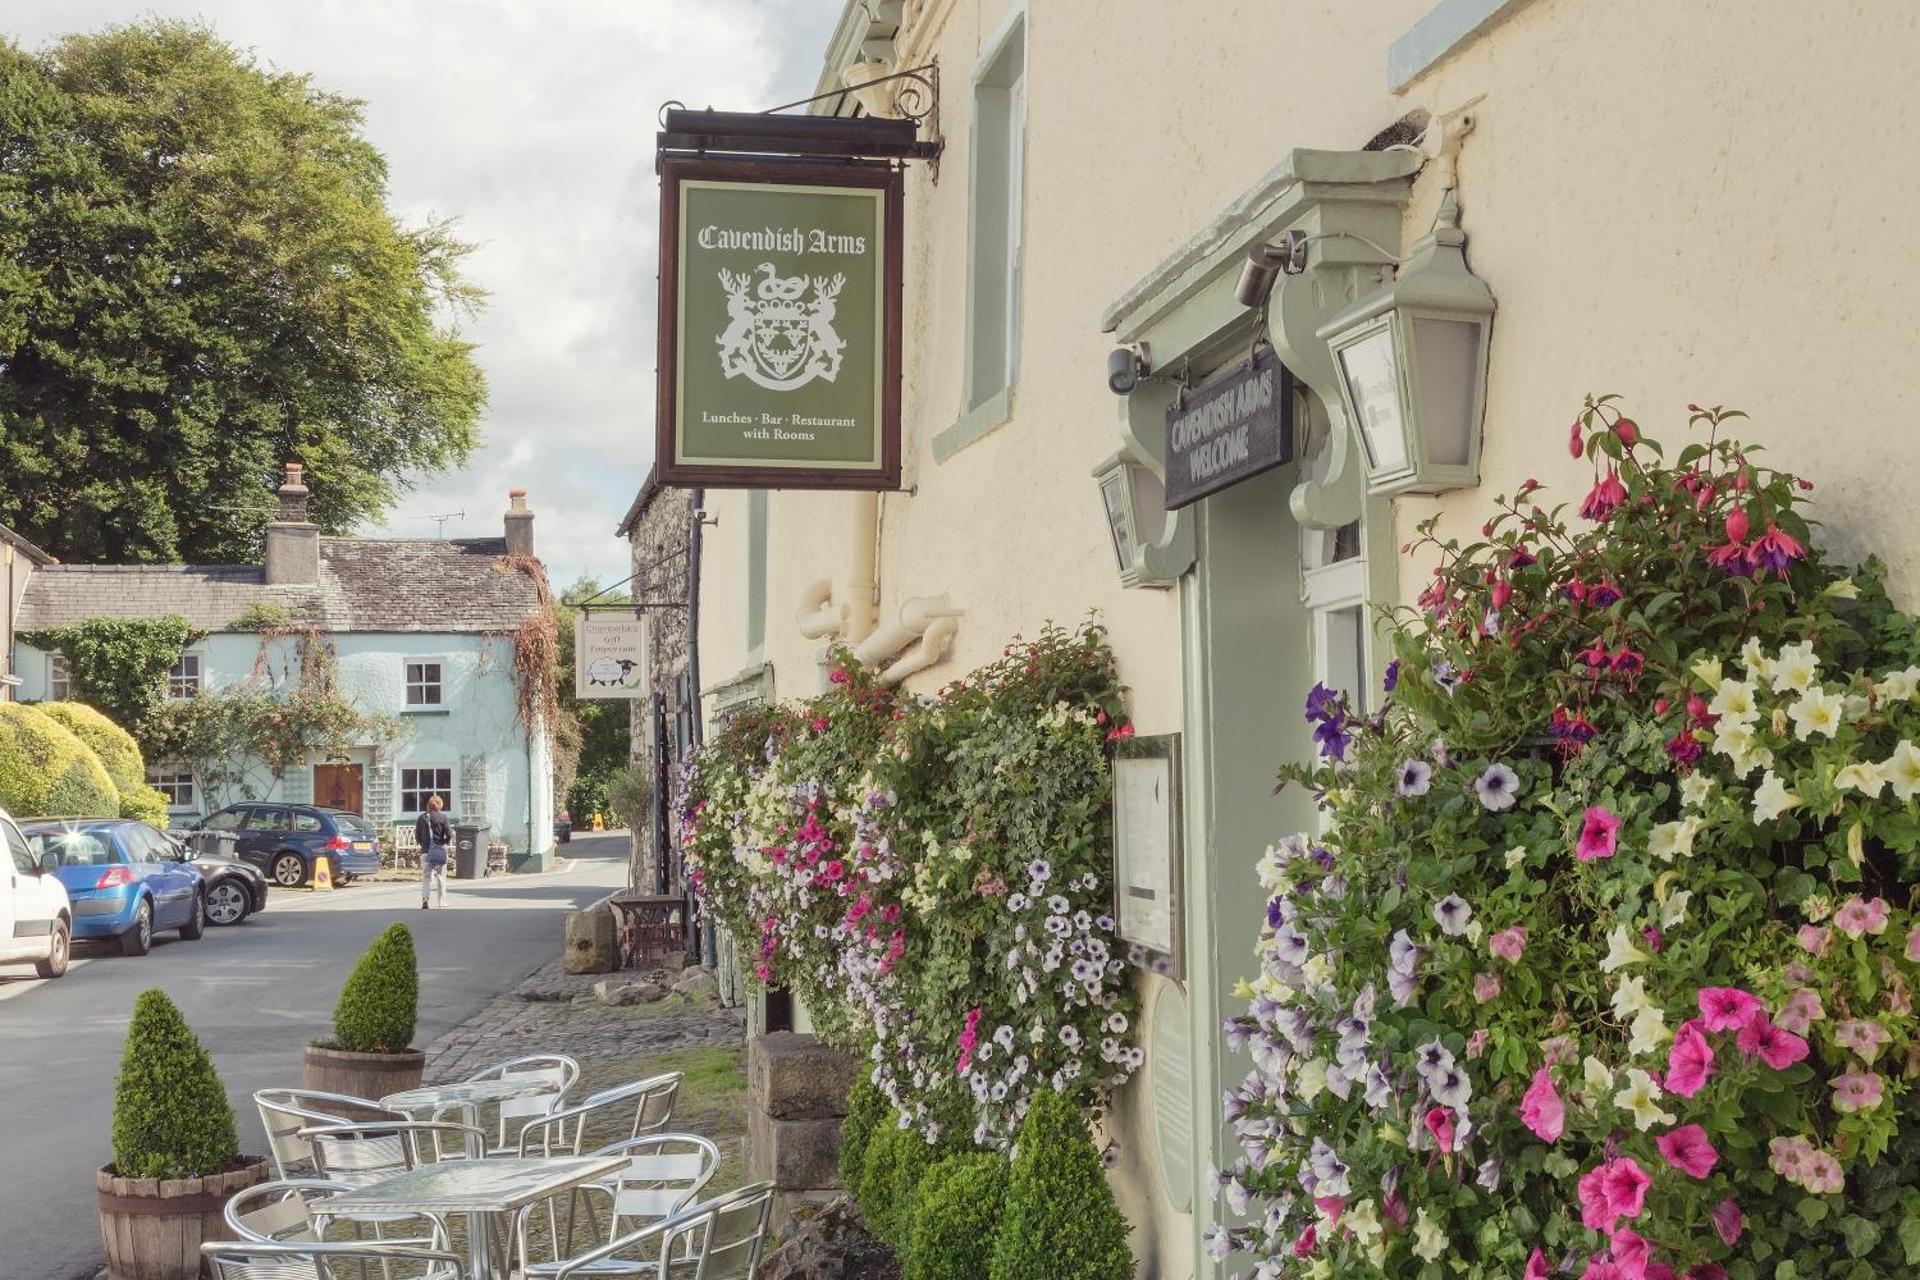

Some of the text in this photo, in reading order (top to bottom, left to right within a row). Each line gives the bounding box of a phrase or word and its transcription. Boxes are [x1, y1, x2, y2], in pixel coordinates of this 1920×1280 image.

[698, 225, 866, 256] Cavendish Arms
[702, 411, 855, 427] Lunches Bar Restaurant
[1171, 369, 1273, 454] CAVENDISH ARMS
[743, 428, 815, 441] with Rooms
[1189, 424, 1249, 482] WELCOME
